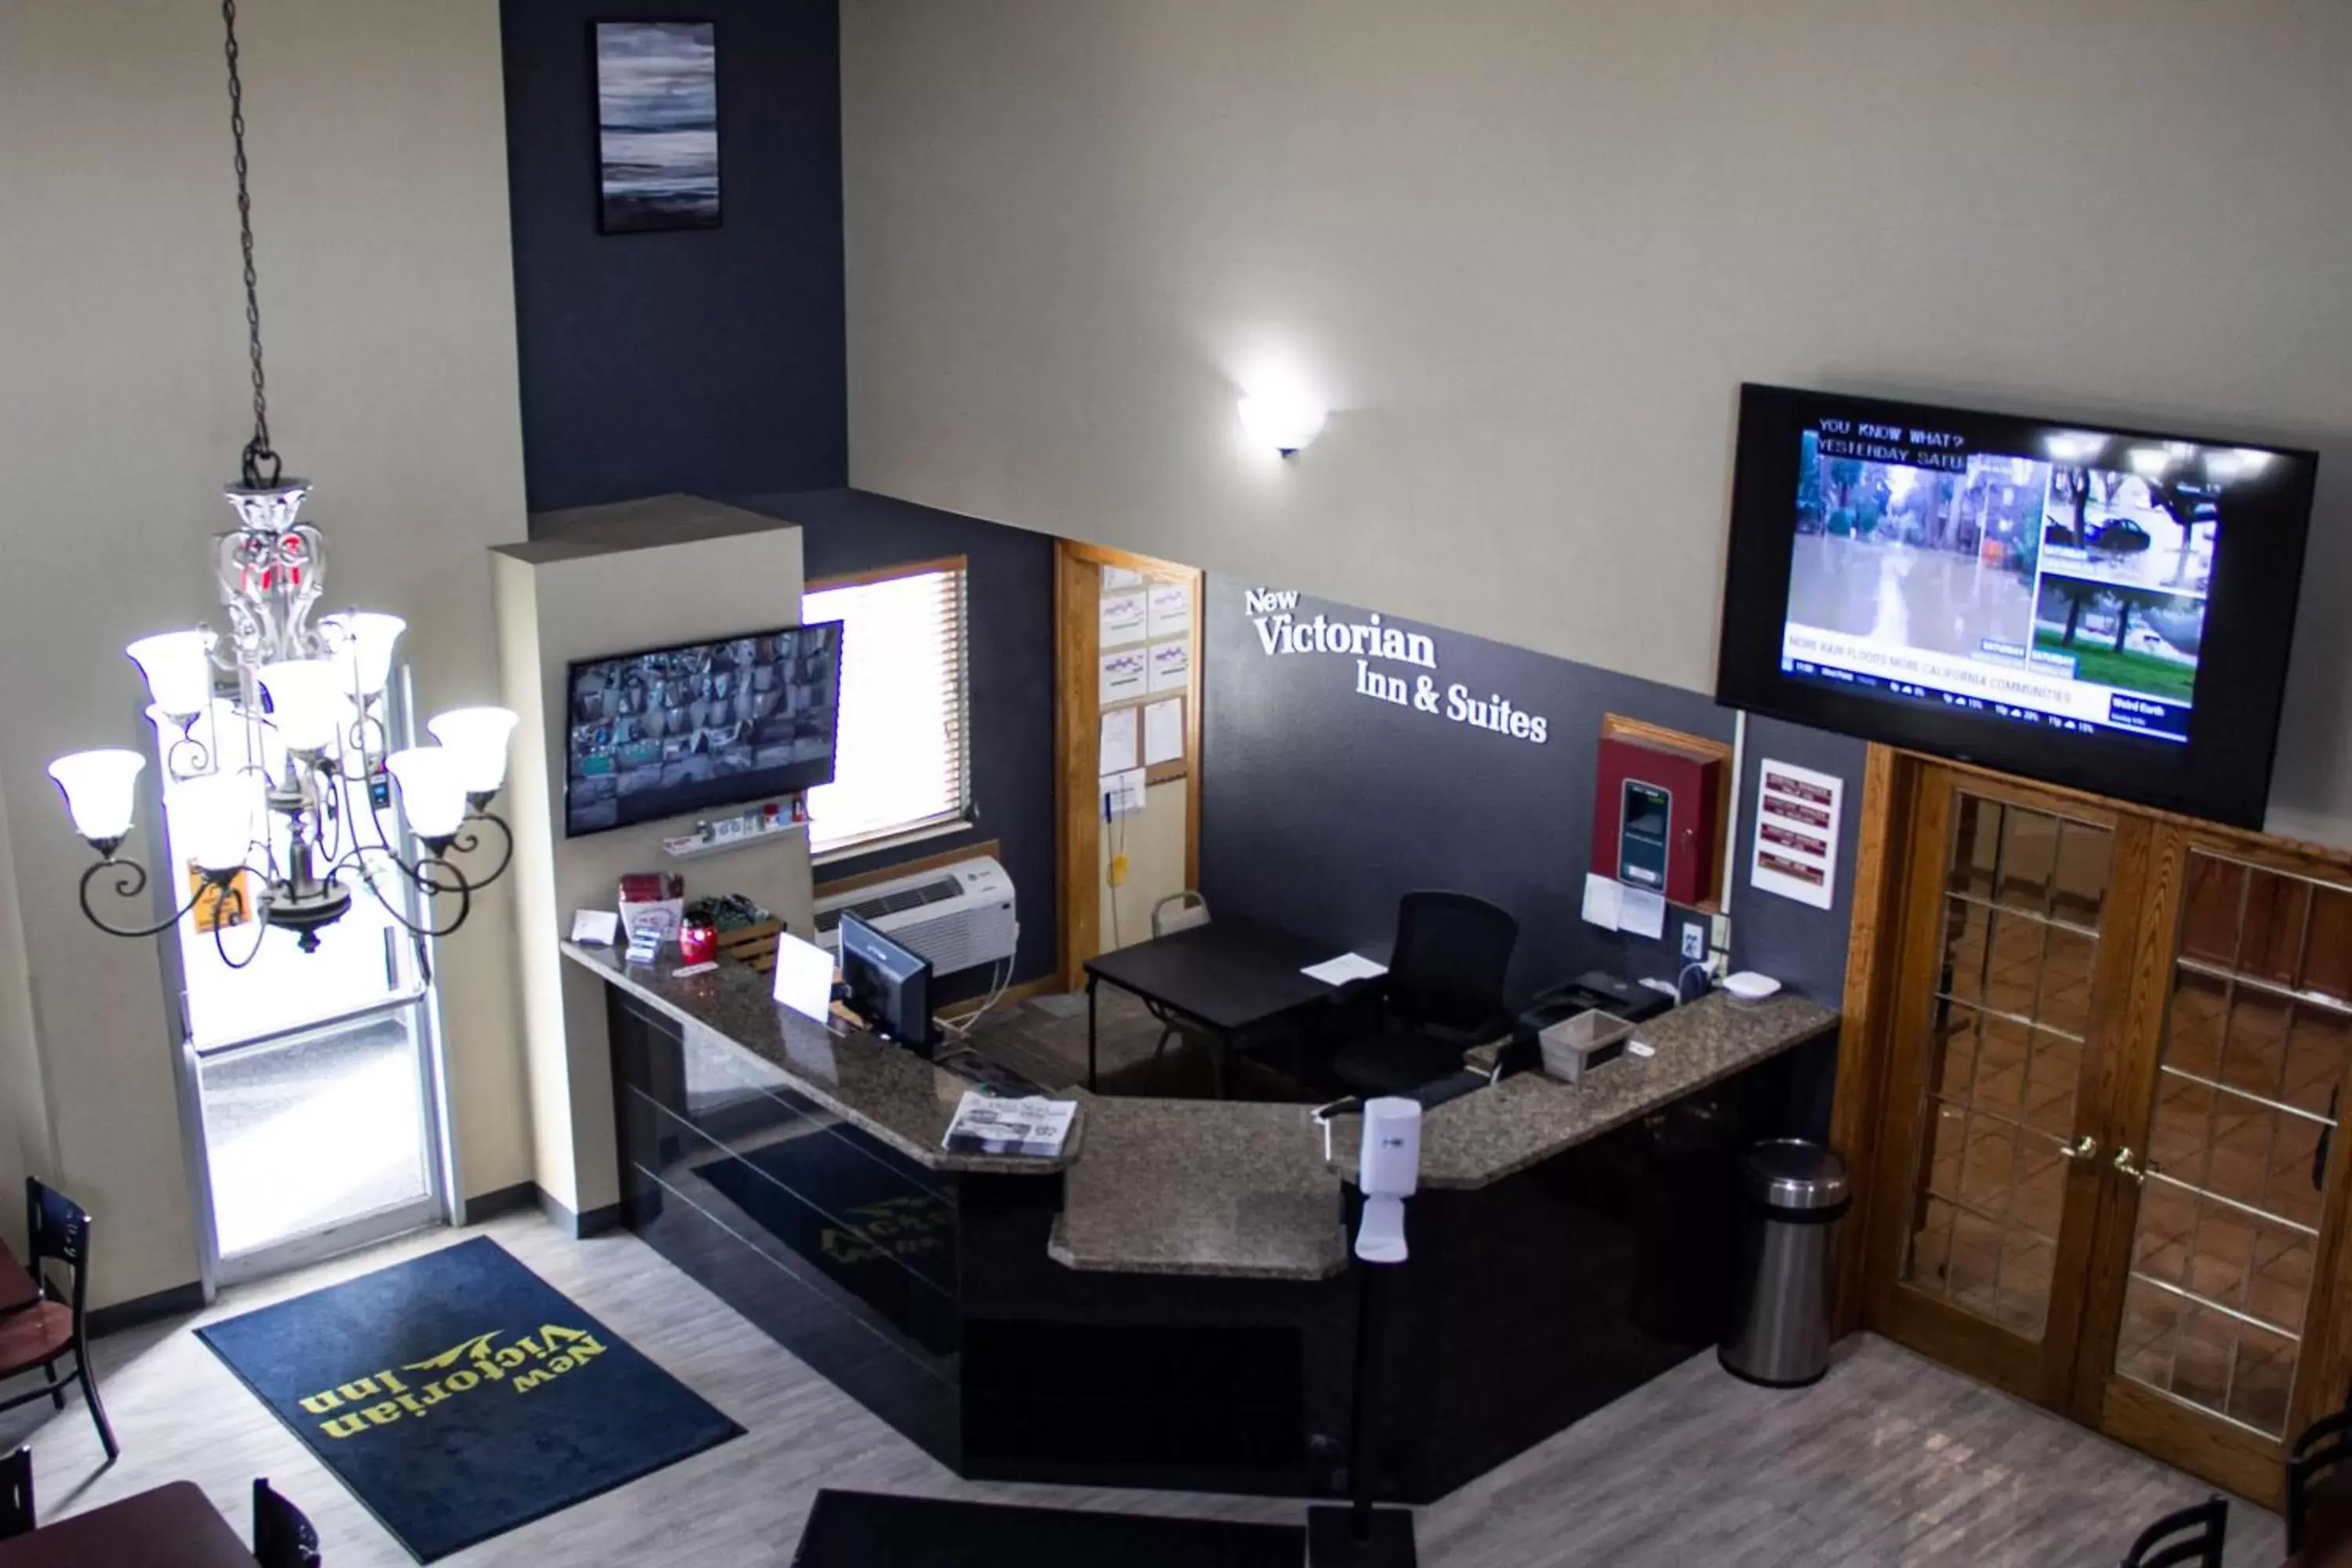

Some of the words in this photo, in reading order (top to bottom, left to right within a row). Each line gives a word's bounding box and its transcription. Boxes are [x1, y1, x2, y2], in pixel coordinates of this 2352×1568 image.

[1818, 438, 1909, 461] YESTERDAY
[1819, 417, 1850, 434] YOU
[1858, 423, 1901, 441] KNOW
[1910, 429, 1965, 448] WHAT?
[1244, 587, 1299, 615] New
[1253, 613, 1437, 669] Victorian
[1356, 659, 1409, 706] Inn
[1414, 675, 1440, 714] &
[1446, 684, 1548, 744] Suites
[318, 1323, 590, 1438] Victorian
[512, 1334, 607, 1394] New
[298, 1369, 408, 1414] Inn
